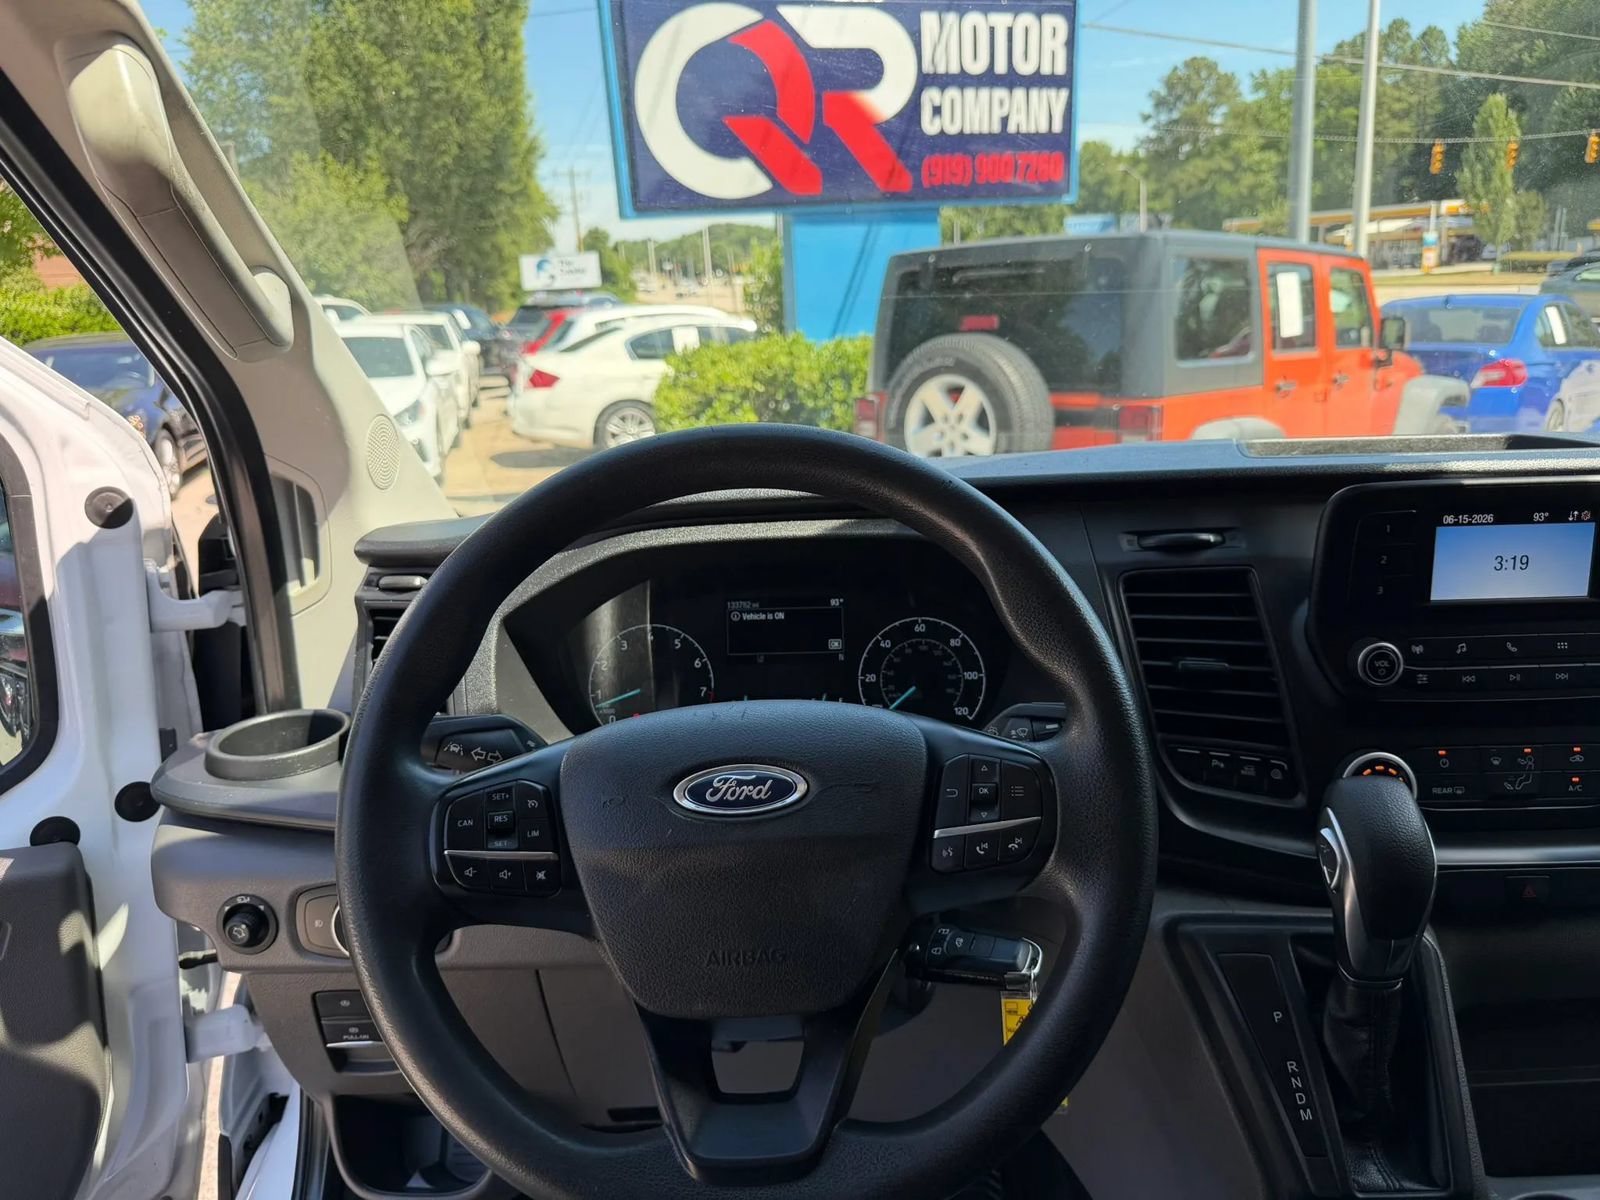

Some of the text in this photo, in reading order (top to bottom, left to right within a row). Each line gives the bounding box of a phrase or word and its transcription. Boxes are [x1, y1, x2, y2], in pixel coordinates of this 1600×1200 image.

[920, 11, 1068, 76] MOTOR
[920, 87, 1069, 136] COMPANY
[921, 152, 973, 188] (919)
[975, 152, 1016, 184] 900
[1442, 512, 1549, 525] 06-15-2026 93°
[1494, 554, 1530, 572] 3:19
[743, 612, 766, 621] Vehicle
[774, 612, 785, 620] ON
[914, 623, 926, 633] 60
[620, 640, 628, 651] 3
[673, 639, 682, 649] 5
[880, 639, 892, 648] 40
[949, 638, 961, 647] 80
[601, 661, 608, 671] 2
[693, 658, 702, 668] 6
[865, 673, 876, 682] 20
[963, 671, 978, 680] 100
[699, 686, 707, 697] 7
[953, 707, 969, 716] 120
[706, 774, 772, 803] Ford
[978, 786, 989, 794] OK
[1568, 784, 1583, 792] A/C
[457, 819, 473, 827] CAN
[706, 949, 787, 967] AIRBAG
[1273, 1011, 1282, 1023] P
[1287, 1061, 1298, 1073] R
[1291, 1076, 1303, 1088] N
[1295, 1092, 1306, 1105] D
[1300, 1108, 1313, 1121] M
